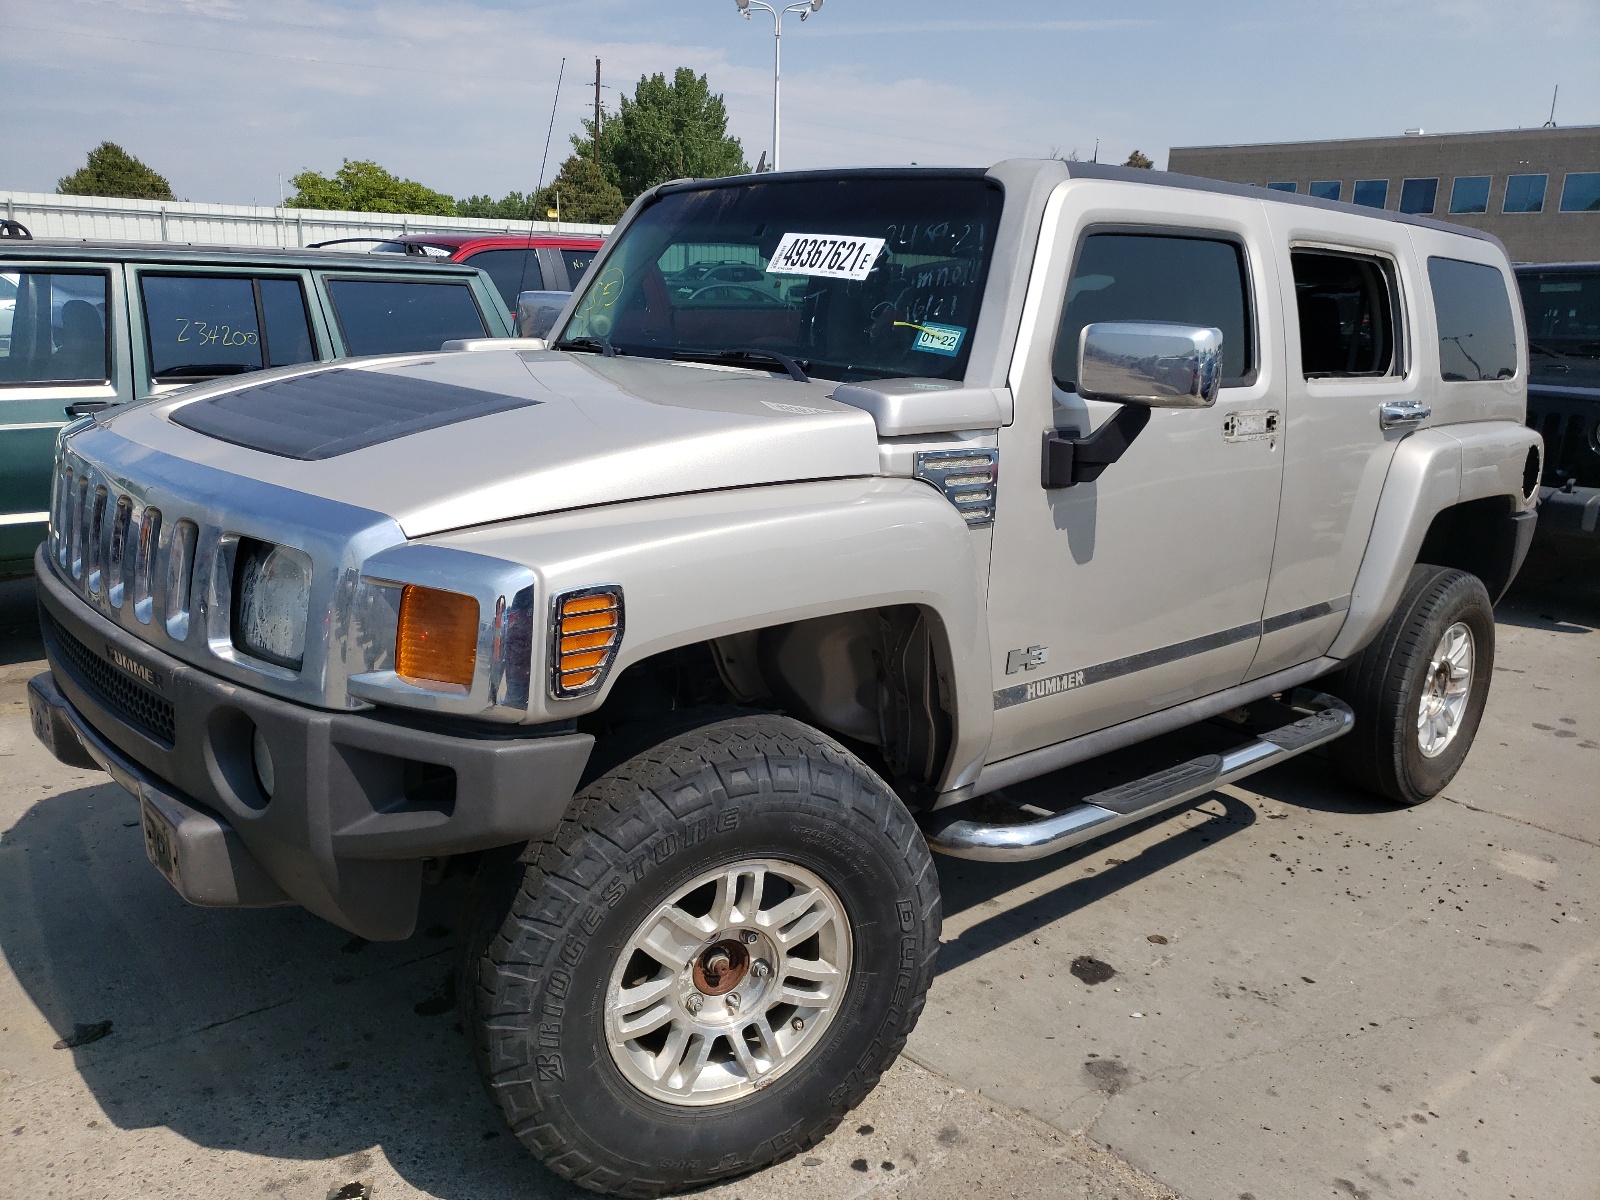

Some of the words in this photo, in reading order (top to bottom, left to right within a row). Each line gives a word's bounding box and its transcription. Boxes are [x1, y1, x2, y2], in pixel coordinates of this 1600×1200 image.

[176, 318, 258, 346] 234200
[1027, 671, 1084, 699] HUMMER
[537, 804, 741, 1084] BRIDGESTONE
[829, 899, 916, 1108] DUELER
